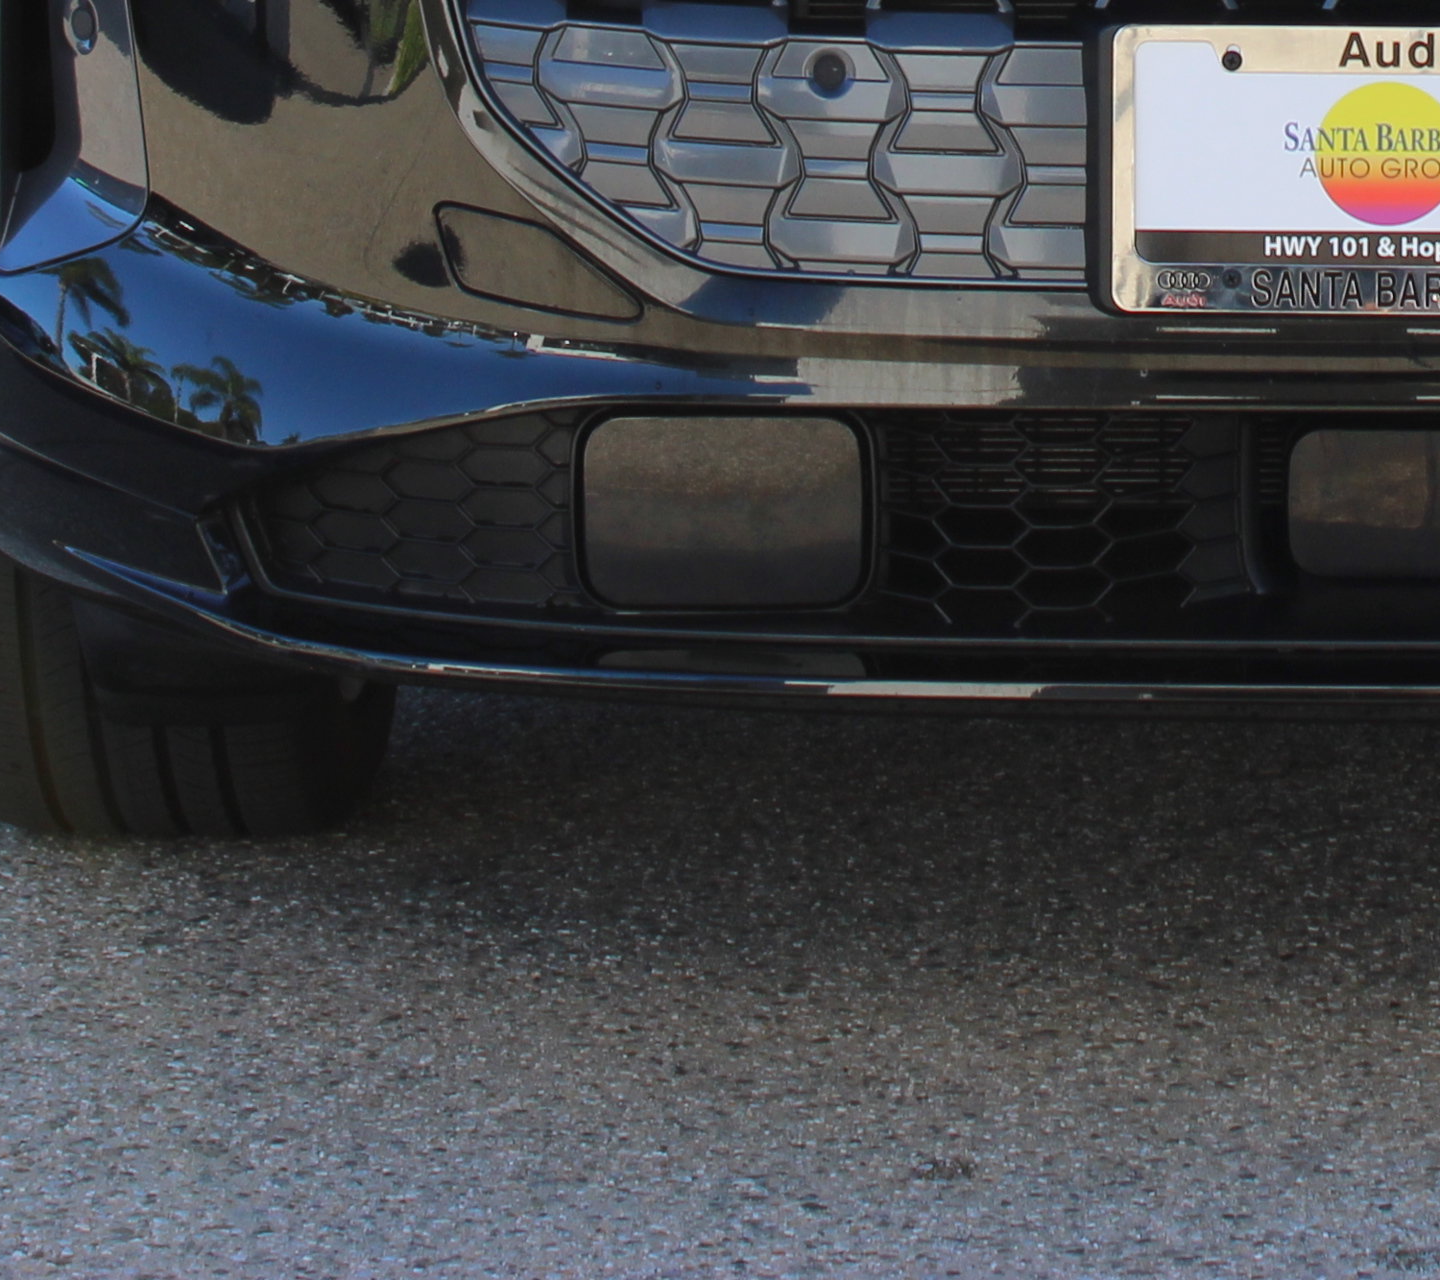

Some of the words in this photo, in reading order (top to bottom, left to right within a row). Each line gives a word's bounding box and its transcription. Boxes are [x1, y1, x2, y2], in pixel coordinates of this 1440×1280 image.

[1283, 121, 1370, 152] SANTA
[1299, 157, 1371, 178] AUTO
[1264, 236, 1323, 258] HWY
[1328, 236, 1371, 258] 101
[1376, 236, 1396, 258] &
[1250, 269, 1364, 309] SANTA
